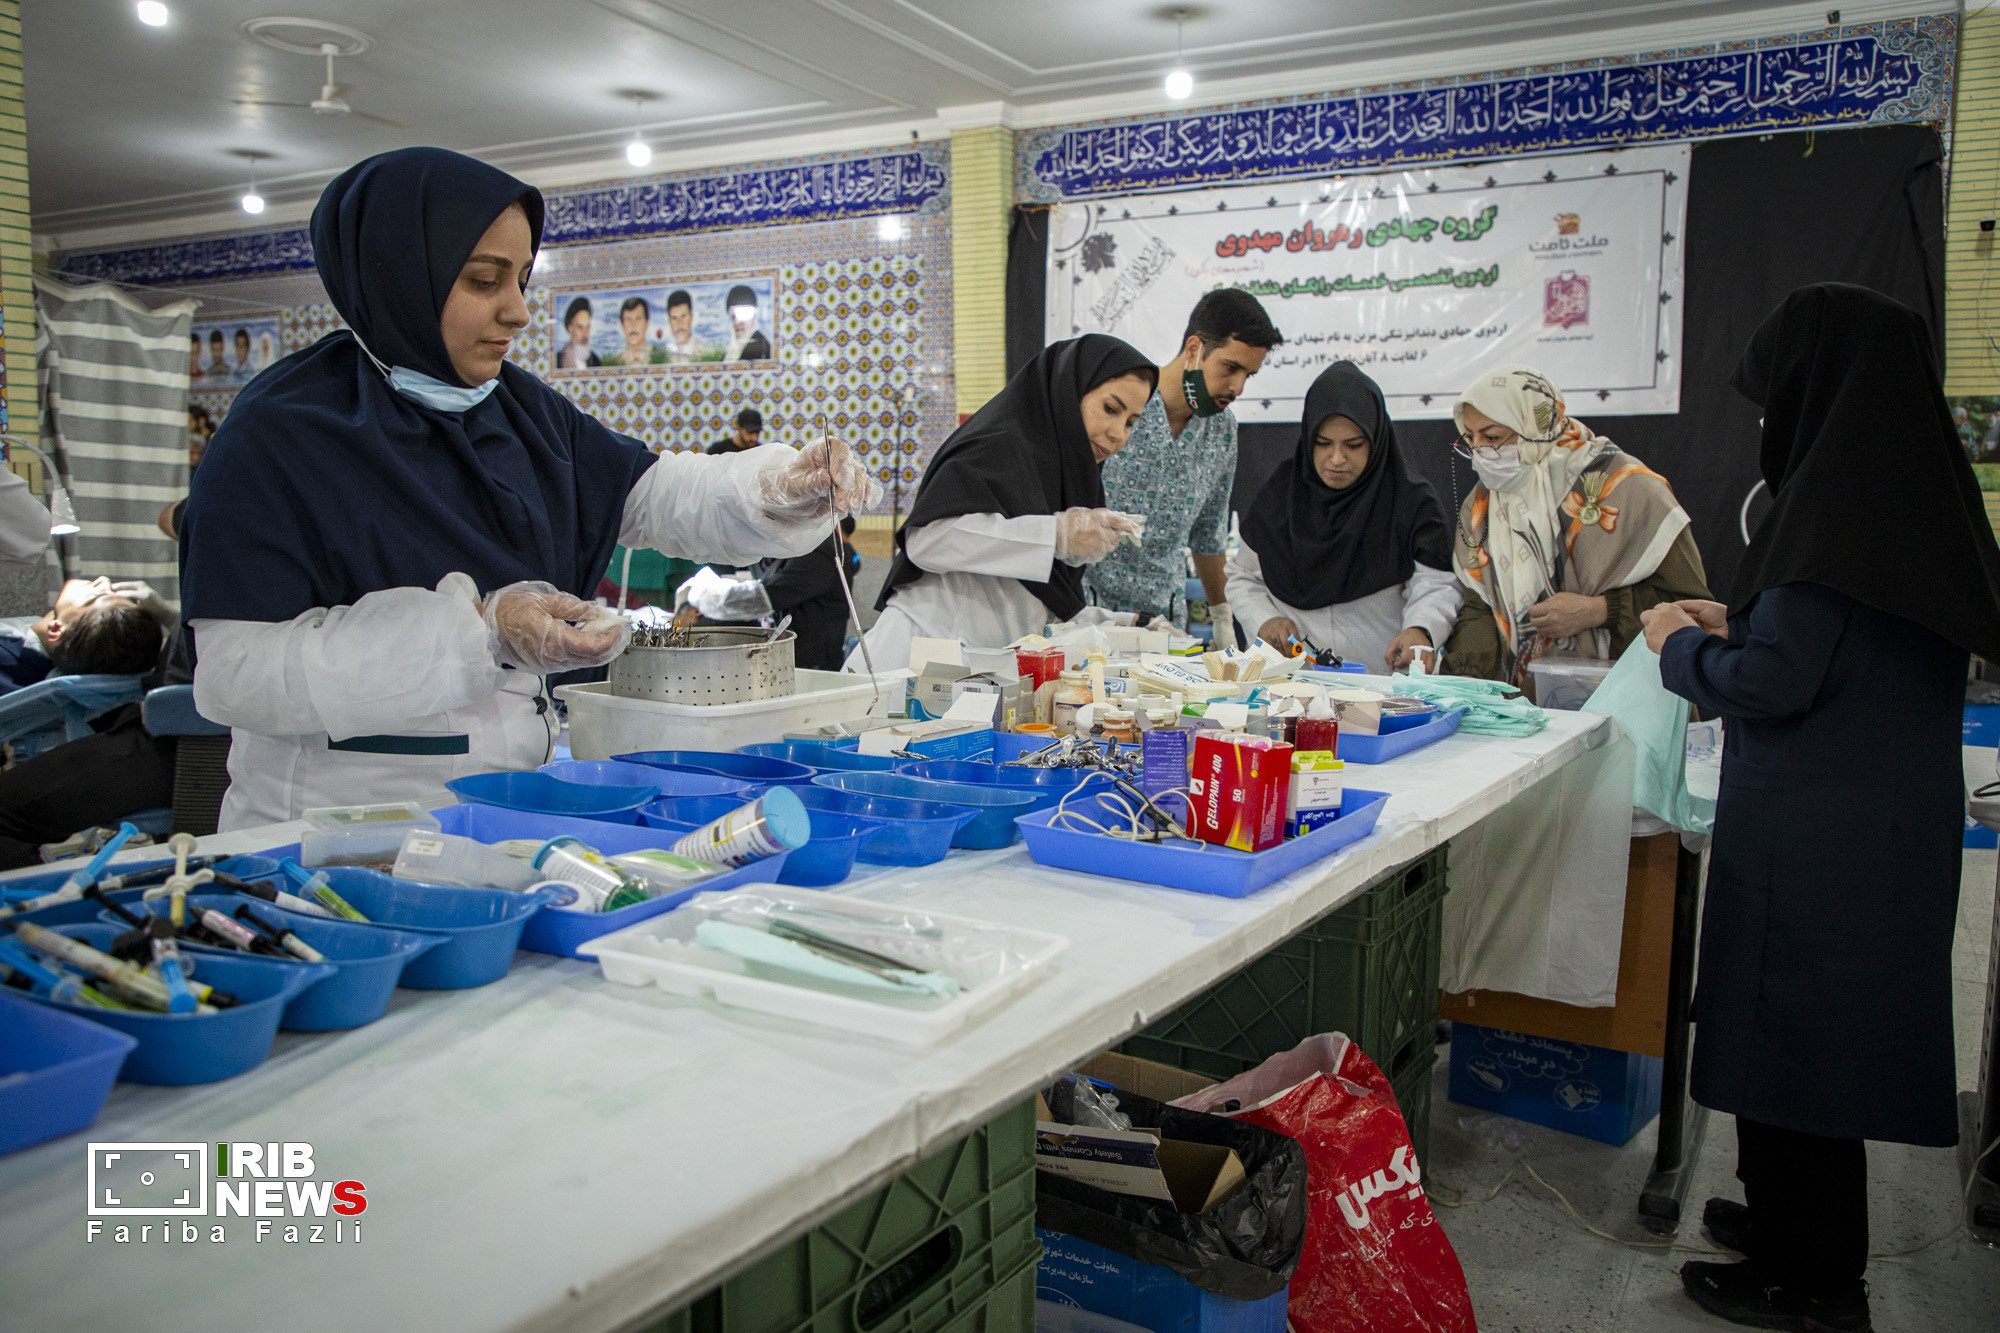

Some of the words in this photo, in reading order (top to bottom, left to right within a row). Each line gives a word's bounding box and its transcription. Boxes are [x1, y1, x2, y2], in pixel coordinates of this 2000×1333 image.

[1441, 204, 1498, 241] گروه
[1286, 219, 1363, 252] رهروان
[1366, 213, 1440, 248] جهادی
[1215, 229, 1283, 259] مهدوی
[1572, 234, 1609, 250] ملت
[1453, 264, 1499, 288] اردوی
[1379, 327, 1437, 343] دندانپزشکی
[1439, 326, 1472, 341] جهادی
[1475, 323, 1508, 338] اردوی
[1212, 754, 1223, 774] 400
[1232, 789, 1242, 803] 50
[1094, 1147, 1123, 1160] Safety
[1044, 1246, 1063, 1258] شهری
[1064, 1252, 1092, 1265] خدمات
[1038, 1262, 1067, 1276] مدیریت
[1093, 1261, 1120, 1275] معاونت
[1068, 1271, 1094, 1285] سازمان
